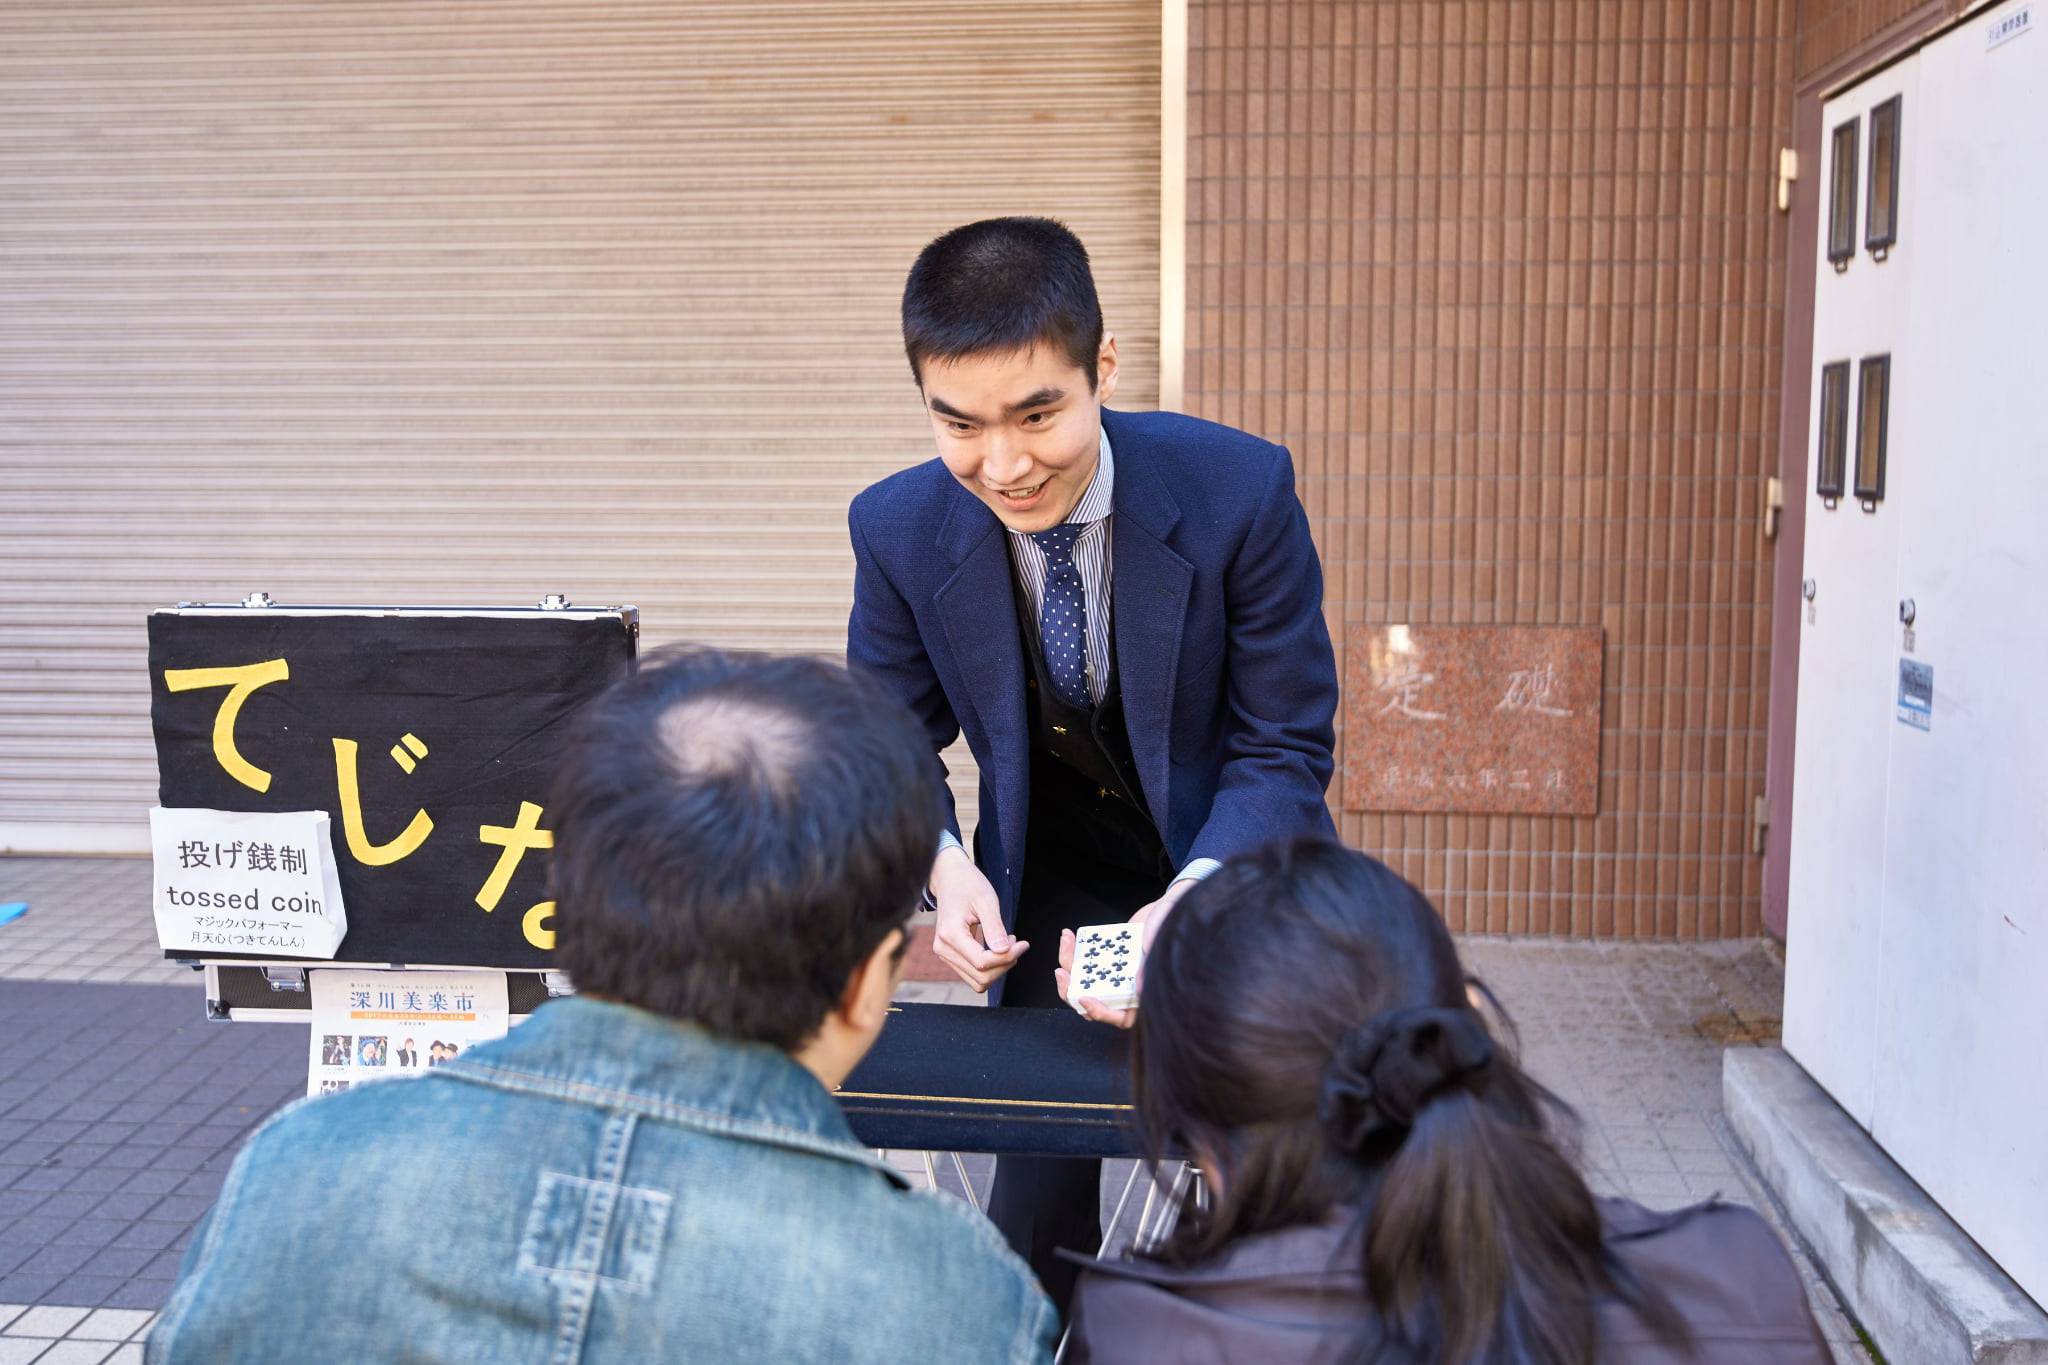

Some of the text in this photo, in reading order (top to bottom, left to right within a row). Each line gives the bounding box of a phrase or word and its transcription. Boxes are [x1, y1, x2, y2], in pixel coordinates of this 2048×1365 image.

[177, 840, 308, 875] 投げ銭制
[166, 886, 323, 916] tossed coin
[194, 916, 303, 931] マジックパフォーマー
[350, 991, 475, 1012] 深川美楽市
